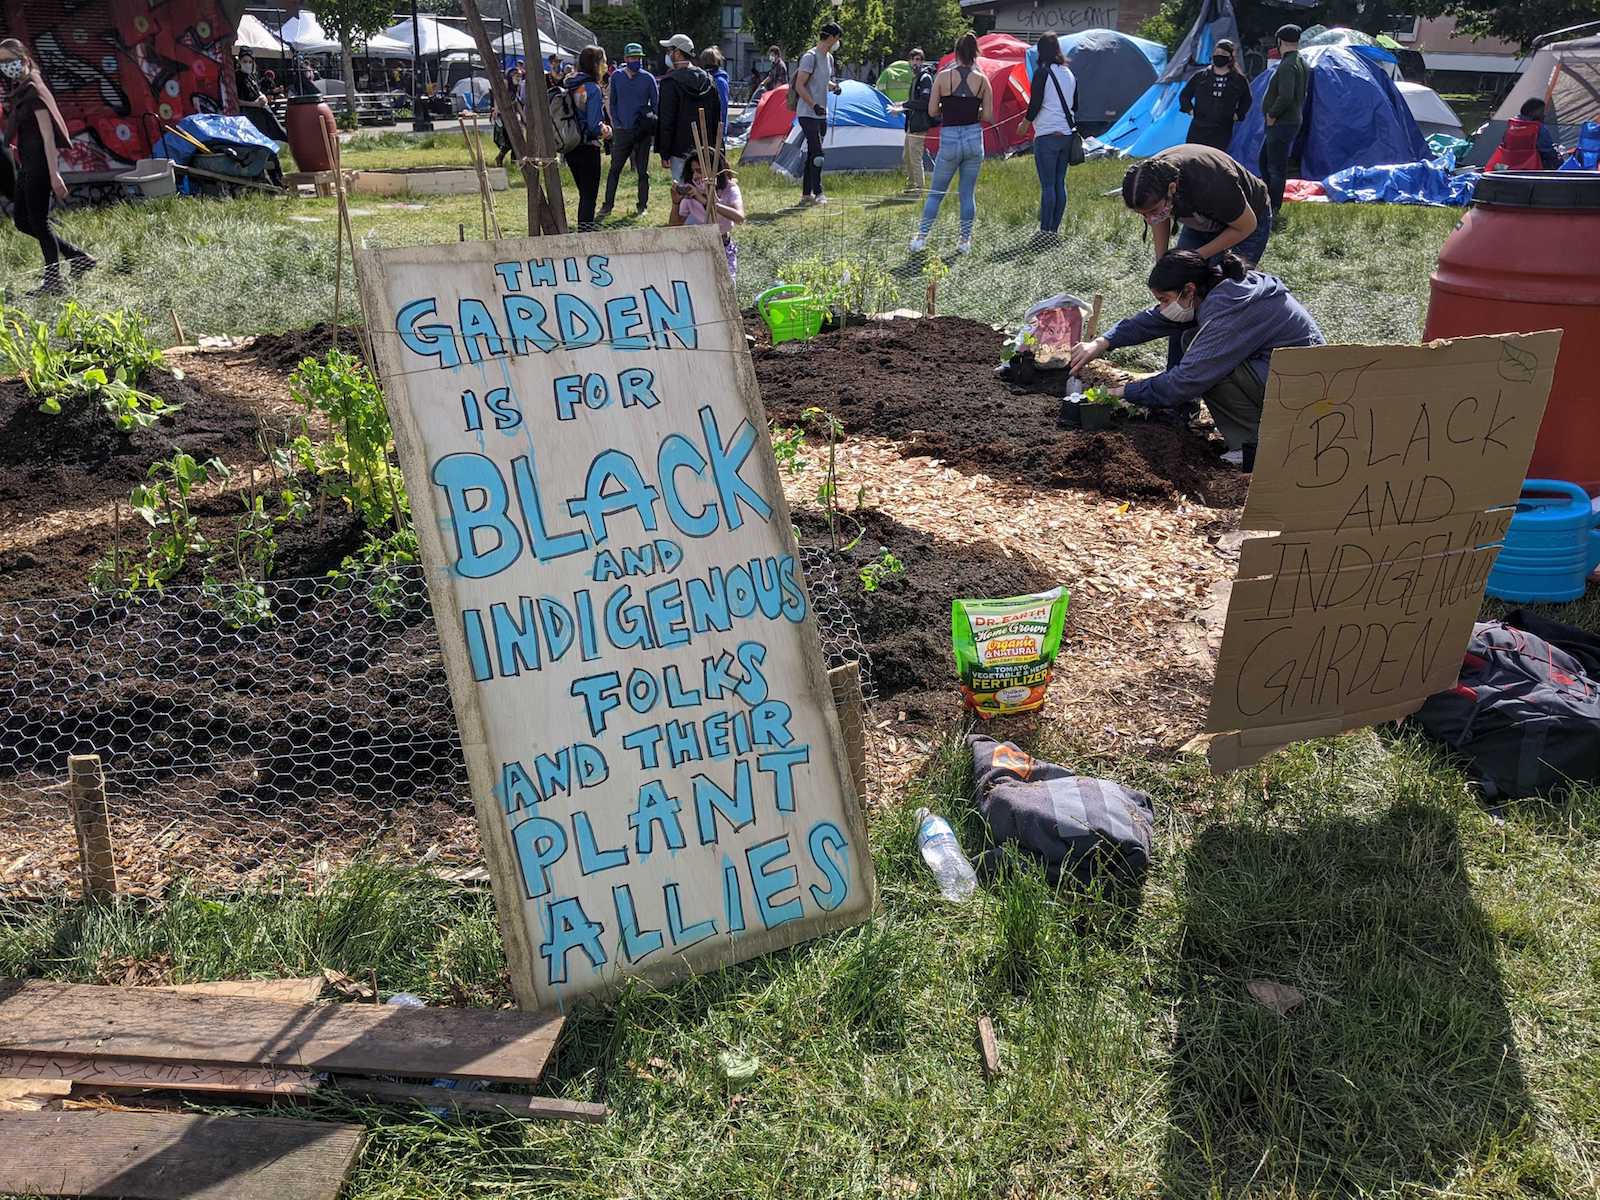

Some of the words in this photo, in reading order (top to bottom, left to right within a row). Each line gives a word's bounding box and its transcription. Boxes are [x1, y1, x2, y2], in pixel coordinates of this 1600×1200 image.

[495, 254, 615, 291] THIS
[396, 280, 698, 369] GARDEN
[461, 388, 522, 432] IS
[554, 367, 661, 421] FOR
[1296, 390, 1516, 488] BLACK
[431, 405, 774, 579] BLACK
[1334, 475, 1455, 536] AND
[593, 539, 683, 581] AND
[462, 554, 807, 682] INDIGENOUS
[974, 629, 1008, 642] Home
[1008, 623, 1048, 634] Grown
[986, 636, 1035, 651] Organic
[1002, 608, 1046, 623] EARTH
[571, 641, 768, 738] FOLKS
[972, 669, 1048, 689] FERTILIZER
[1237, 617, 1449, 716] GARDEN
[502, 742, 609, 815] AND
[623, 700, 795, 769] THEIR
[511, 744, 809, 899] PLANT
[541, 822, 848, 986] ALLIES
